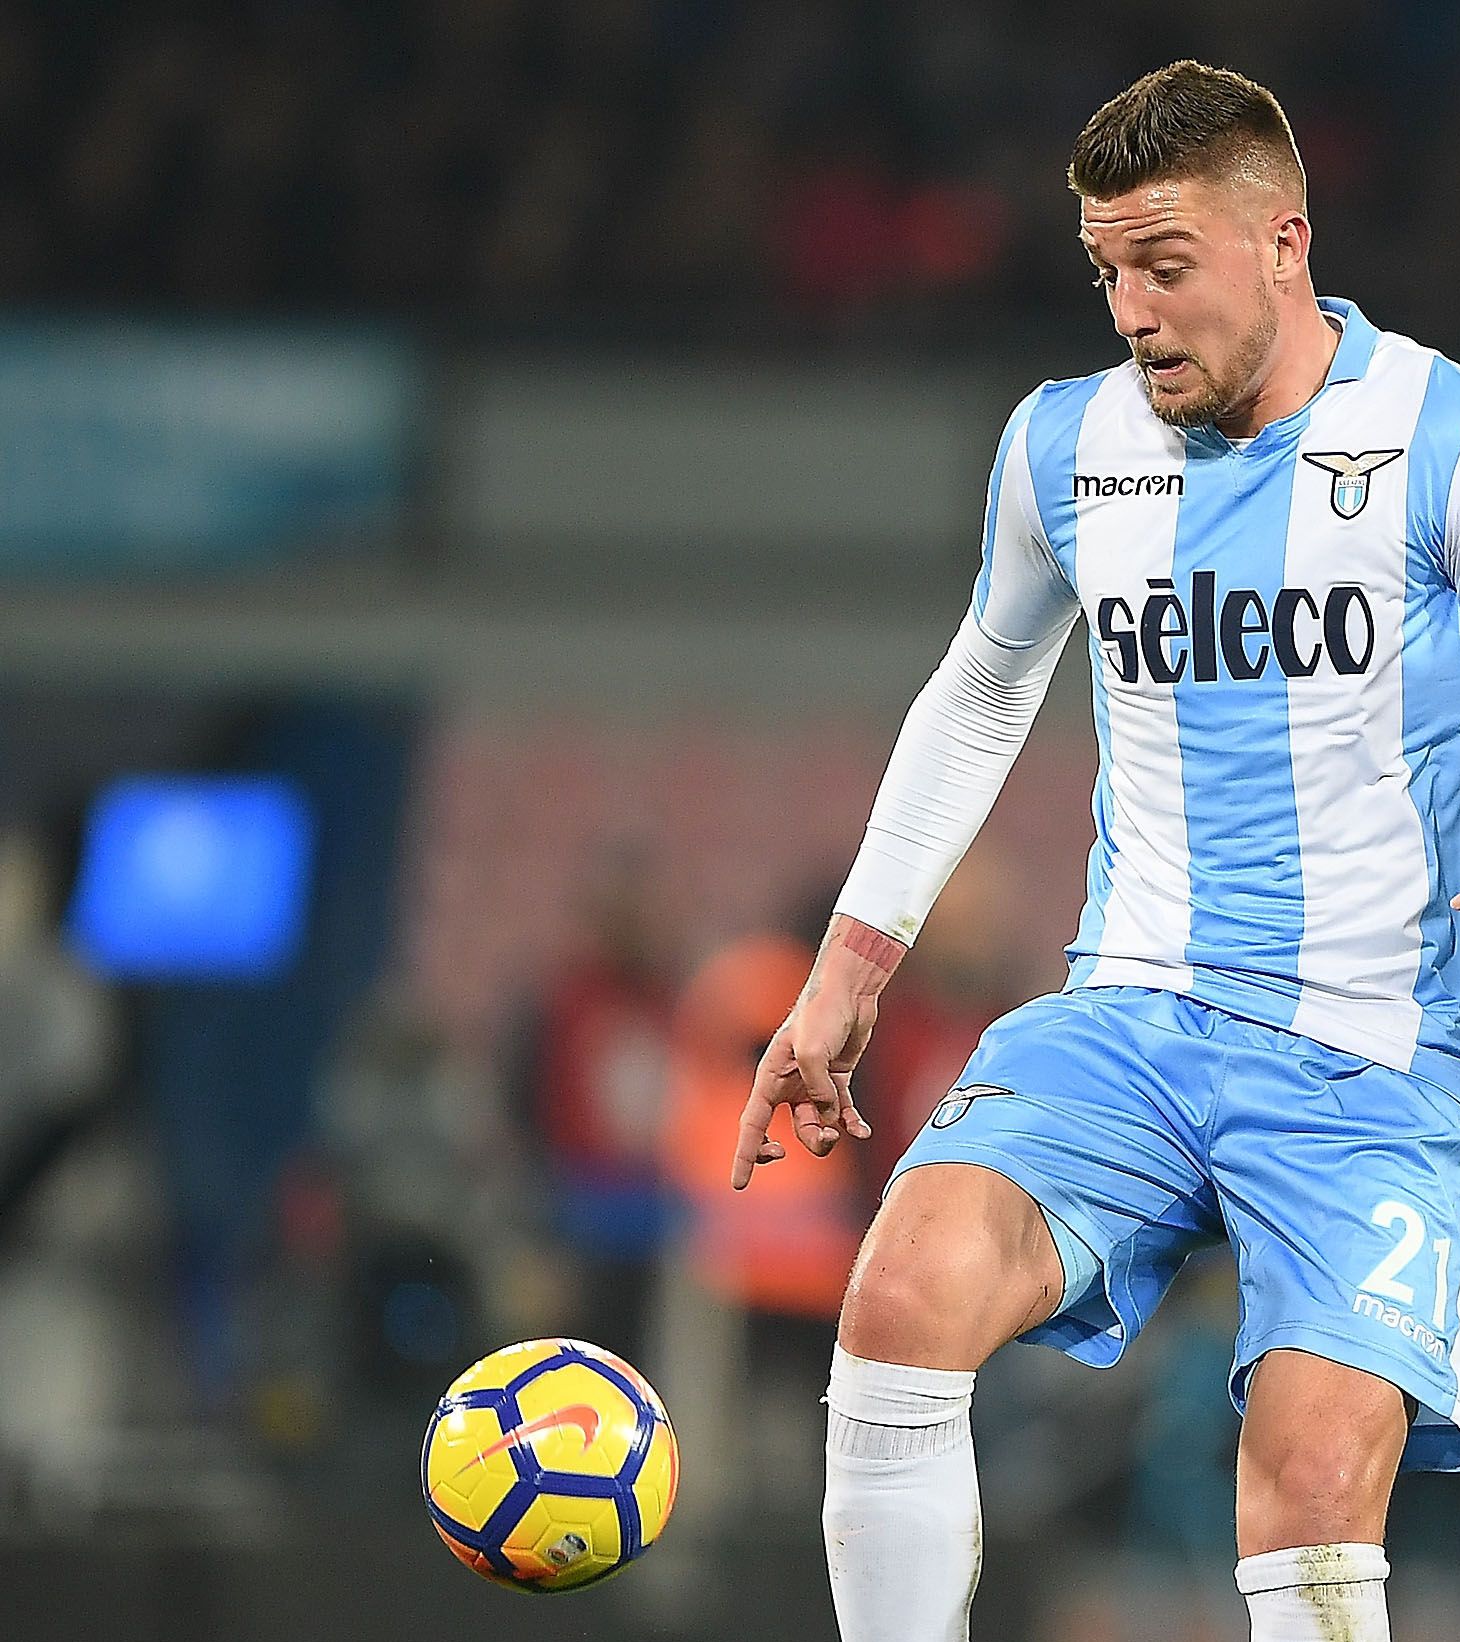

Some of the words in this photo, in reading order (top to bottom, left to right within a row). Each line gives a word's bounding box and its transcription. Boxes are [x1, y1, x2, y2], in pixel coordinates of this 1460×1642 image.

[1073, 474, 1184, 496] macron
[1356, 1200, 1451, 1332] 21
[1352, 1293, 1449, 1363] macron
